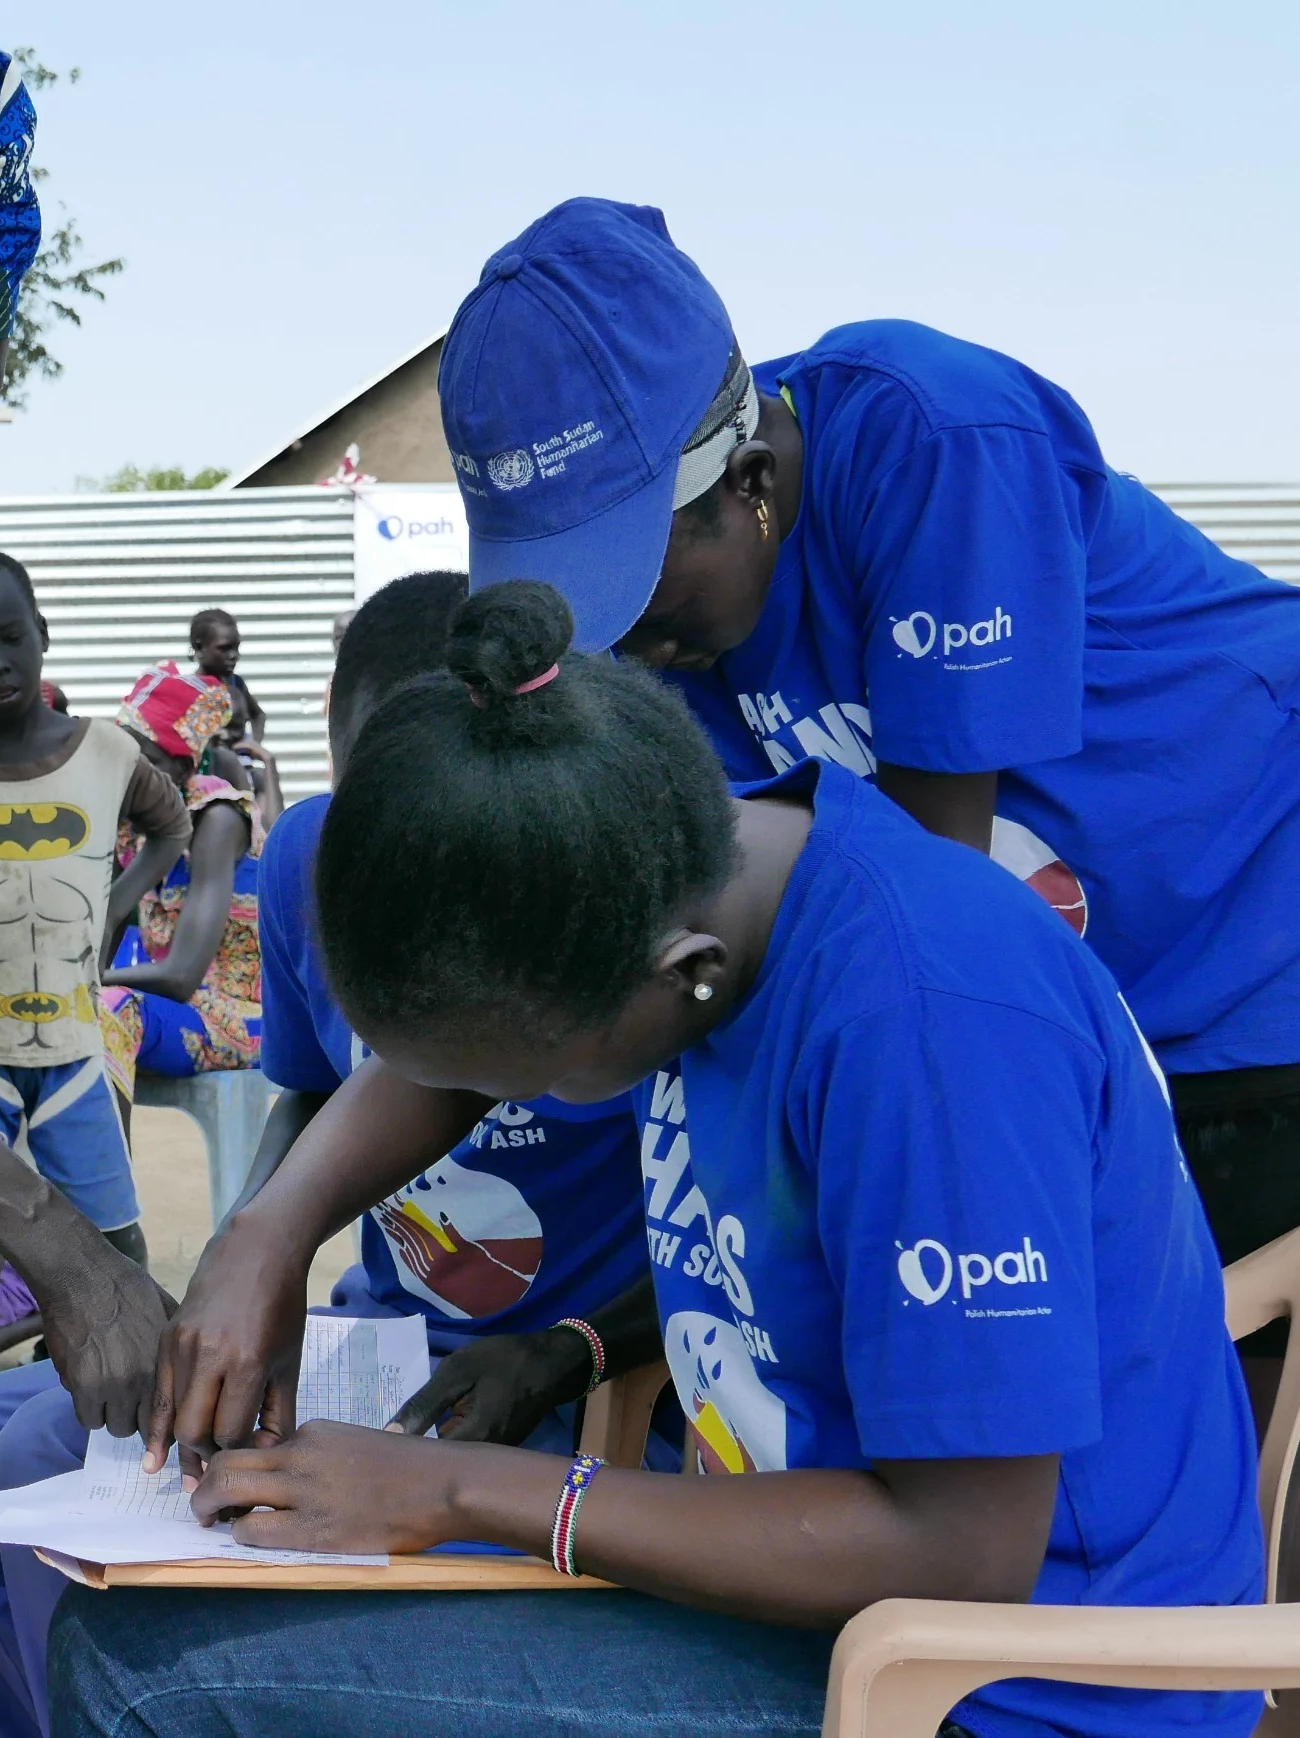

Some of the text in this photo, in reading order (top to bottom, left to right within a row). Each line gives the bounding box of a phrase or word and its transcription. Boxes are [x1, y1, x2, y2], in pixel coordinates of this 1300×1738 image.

[533, 421, 594, 455] South Sudan
[408, 517, 453, 539] pah
[943, 607, 1012, 655] pah
[491, 1127, 546, 1149] ASH
[958, 1237, 1048, 1299] pah
